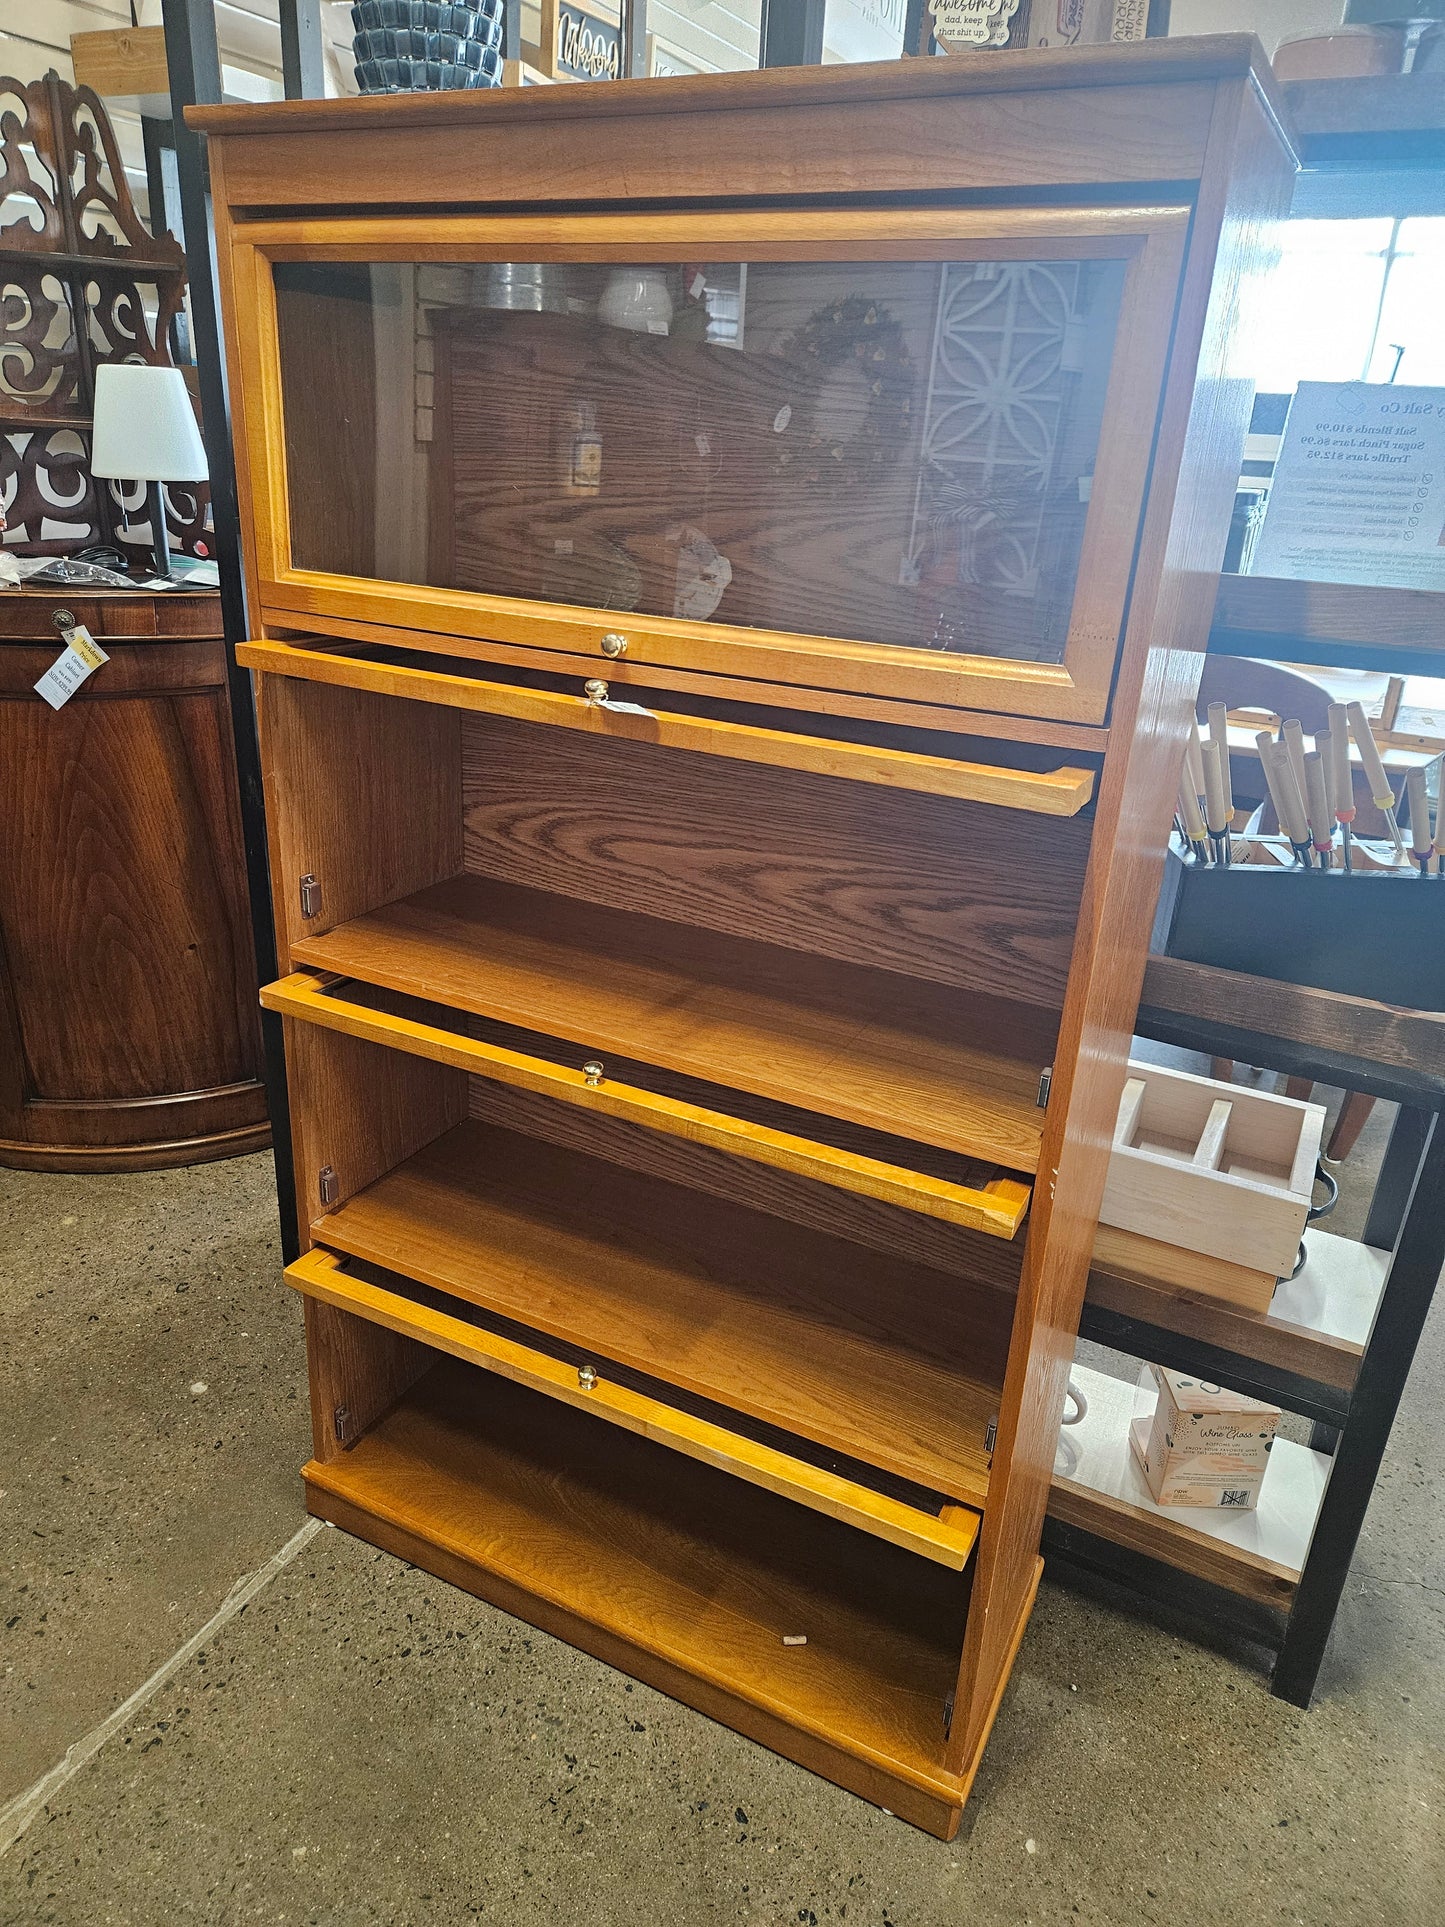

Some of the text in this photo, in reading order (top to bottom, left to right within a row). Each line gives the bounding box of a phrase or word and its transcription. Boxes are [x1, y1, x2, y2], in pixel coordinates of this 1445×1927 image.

[945, 15, 983, 26] dad, keep
[939, 27, 986, 38] that shit up.
[80, 640, 102, 663] Markdown
[80, 651, 89, 663] Price
[71, 655, 84, 670] Corner
[65, 662, 80, 679] Cabinet
[1200, 1429, 1254, 1440] Wine Glass
